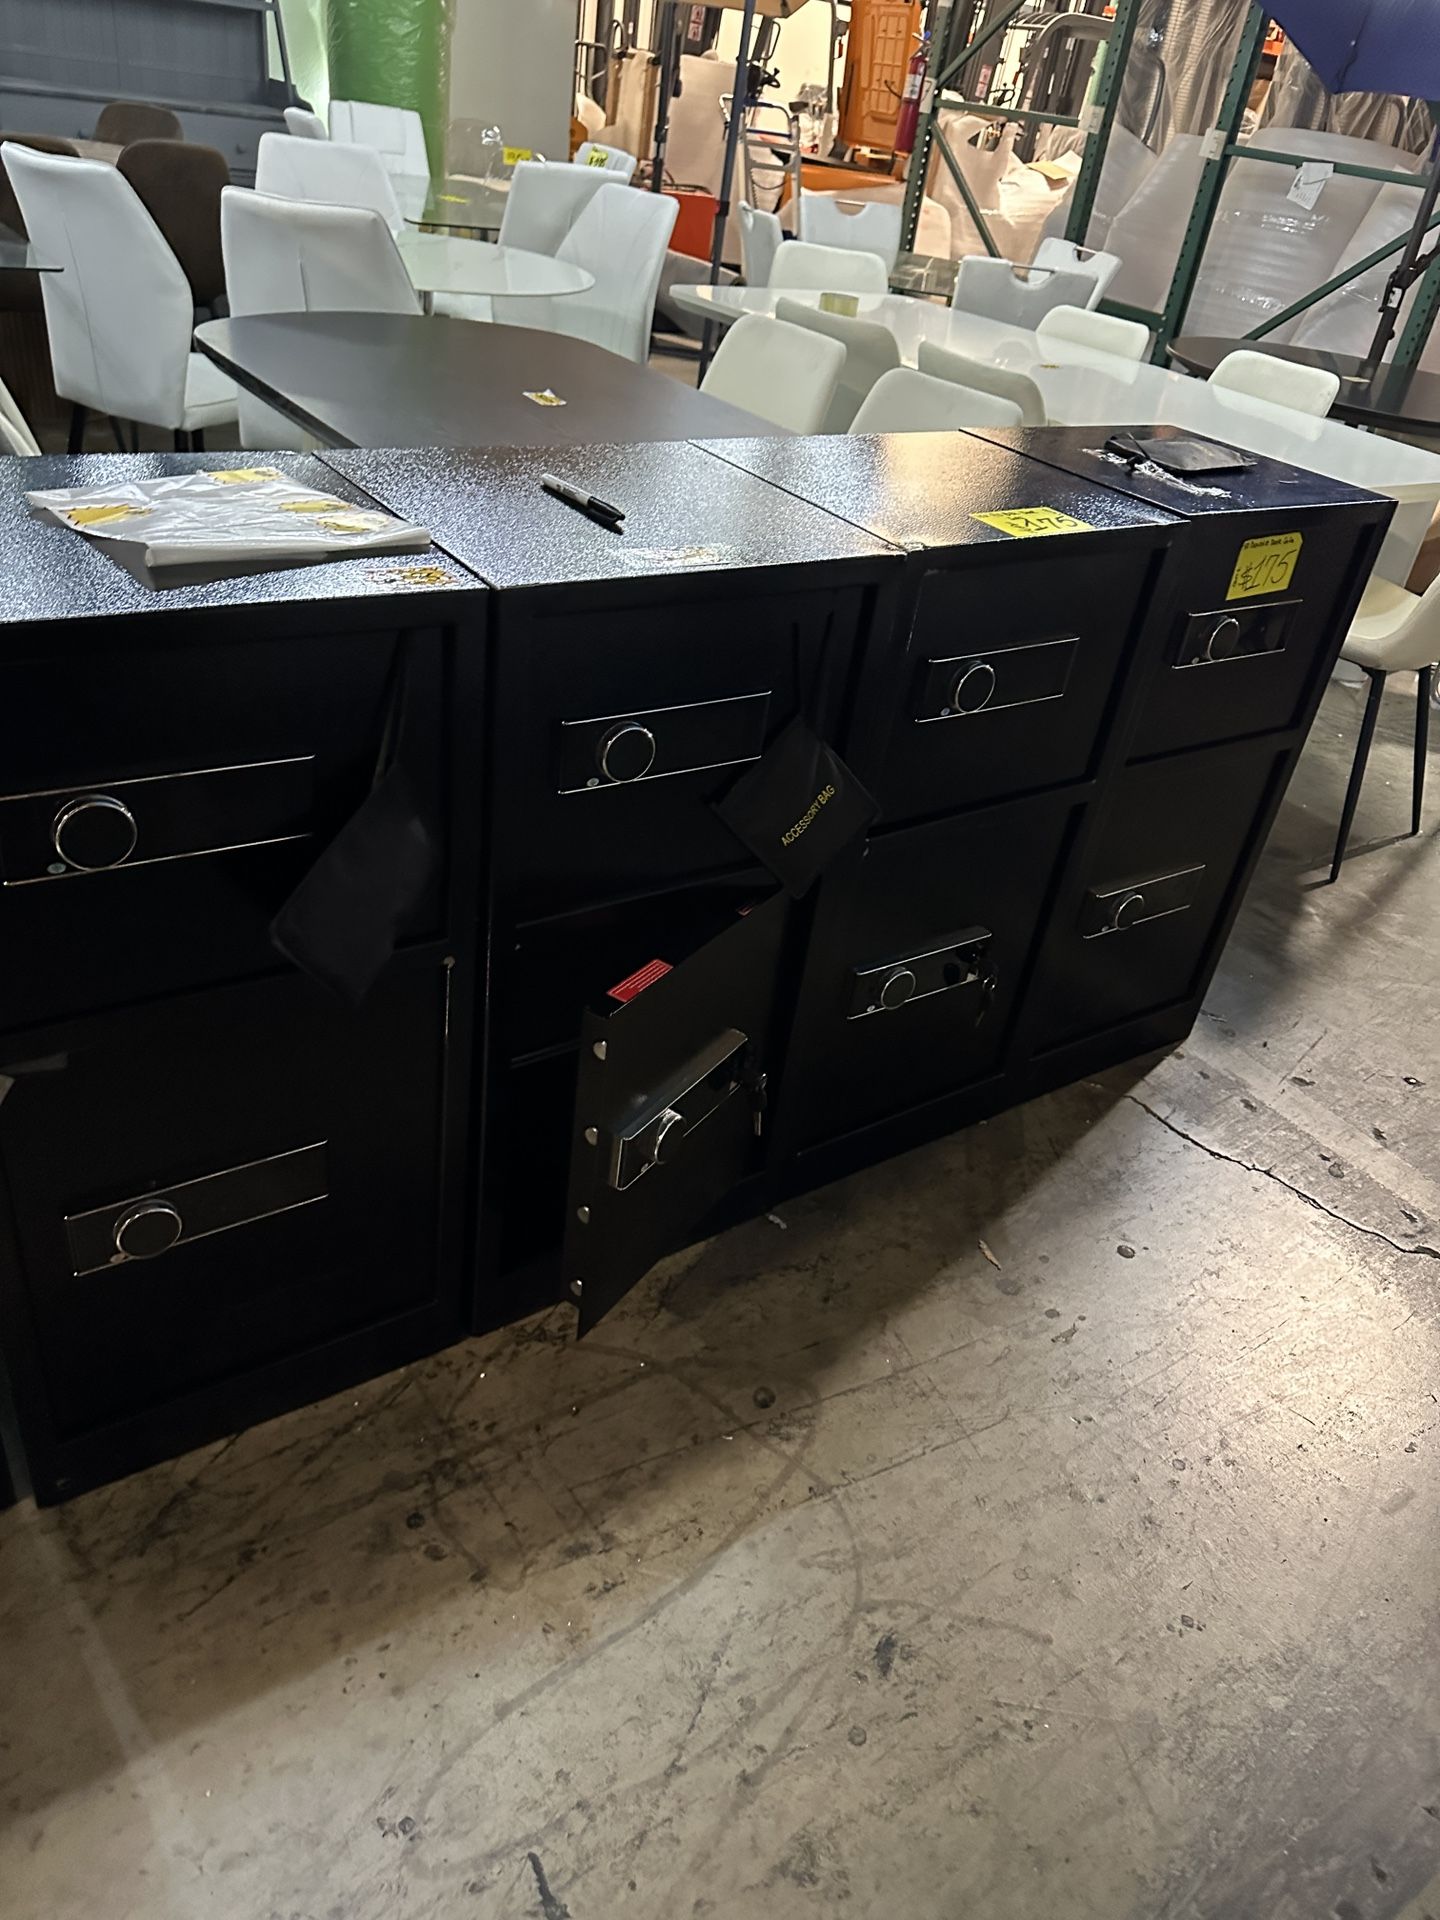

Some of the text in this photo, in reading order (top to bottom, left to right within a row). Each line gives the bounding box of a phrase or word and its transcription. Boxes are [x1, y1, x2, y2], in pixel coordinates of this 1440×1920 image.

[1238, 549, 1297, 591] $175
[781, 784, 835, 847] ACCESSORY BAG
